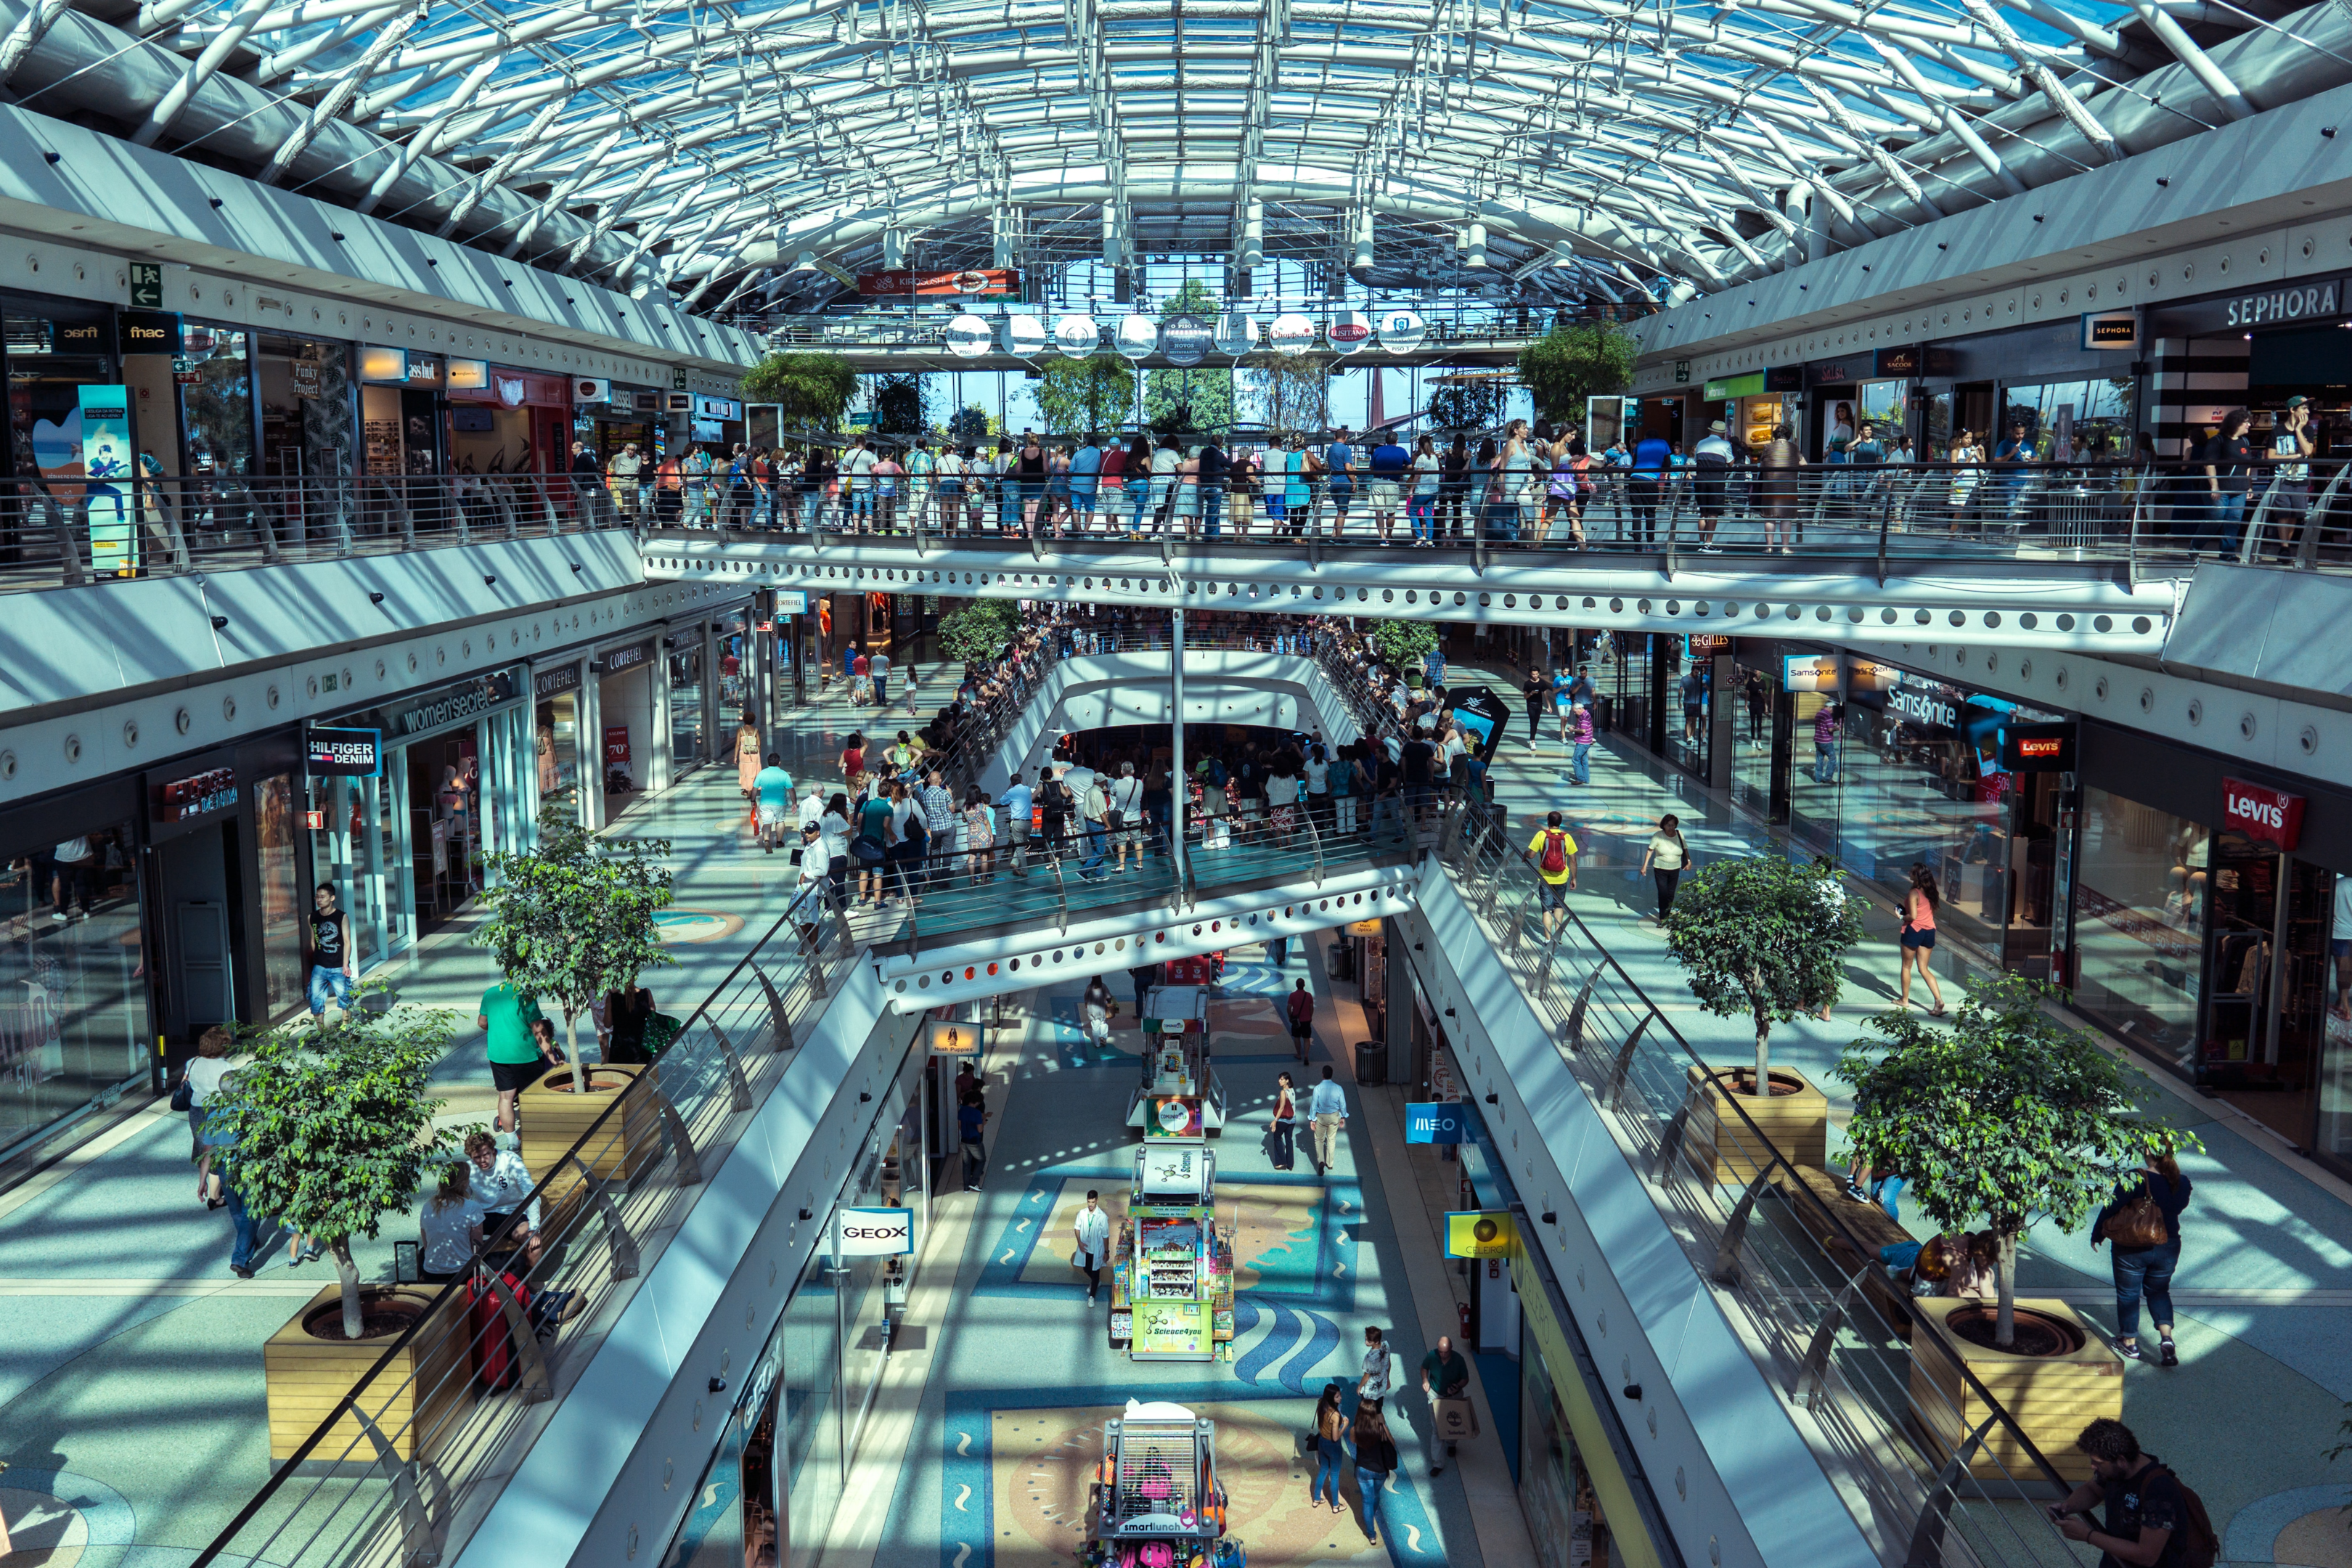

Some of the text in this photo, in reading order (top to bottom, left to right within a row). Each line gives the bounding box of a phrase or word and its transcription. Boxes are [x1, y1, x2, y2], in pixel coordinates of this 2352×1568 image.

[899, 277, 946, 286] KIROSUSHI
[2228, 285, 2335, 326] SEPHORA
[131, 327, 165, 338] fnac
[947, 327, 990, 340] di Casa
[1270, 328, 1313, 340] Chopperia
[295, 363, 318, 380] Funky
[421, 360, 435, 380] hut
[1821, 364, 1845, 381] Salsa
[293, 380, 318, 396] Project
[611, 388, 632, 409] HUSSEL
[1702, 634, 1728, 645] GILLES
[610, 646, 642, 670] CORTEFIEL
[536, 668, 576, 695] CORTEFIEL
[404, 686, 490, 733] women'secret
[1887, 684, 1956, 729] Samsonite
[311, 740, 374, 754] HILFIGER
[608, 743, 627, 755] 70%
[2022, 743, 2059, 751] Levi's
[334, 754, 374, 764] DENIM
[176, 767, 235, 802] HILFIGER
[201, 787, 238, 814] DENIM
[2229, 793, 2283, 829] Levi's
[3, 1053, 44, 1094] ATÉ 50%
[91, 1082, 121, 1106] HILFIGER
[103, 1092, 121, 1107] DENIM
[1415, 1117, 1455, 1131] MEO
[844, 1226, 907, 1238] GEOX
[1466, 1246, 1504, 1254] CELEIRO
[1524, 1269, 1550, 1344] CELEIRO
[743, 1336, 782, 1430] GEOX
[1124, 1522, 1180, 1531] smartlunch
